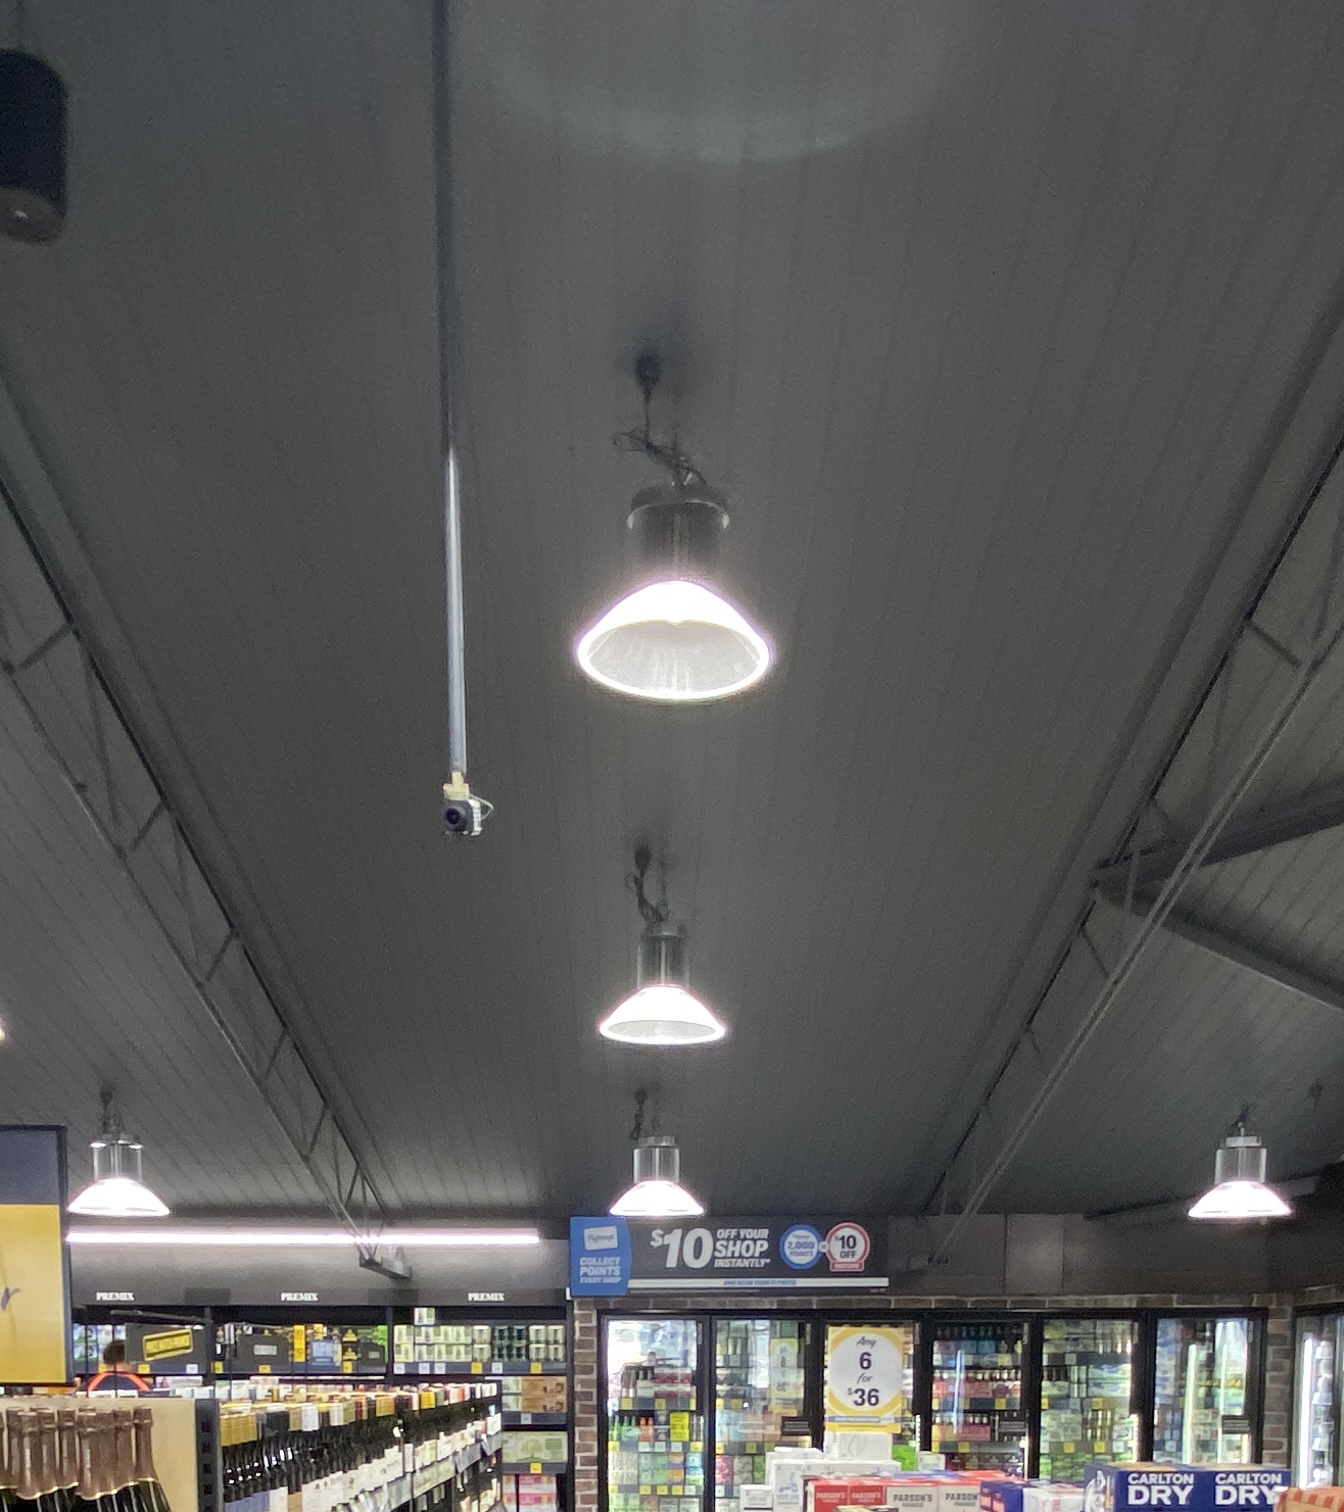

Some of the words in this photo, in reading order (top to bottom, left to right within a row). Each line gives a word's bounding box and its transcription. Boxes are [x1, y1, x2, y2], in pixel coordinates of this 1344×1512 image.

[716, 1229, 738, 1239] OFF
[739, 1228, 769, 1239] YOUR
[787, 1240, 815, 1250] 2,000
[834, 1235, 857, 1250] $10
[650, 1228, 714, 1270] $10
[714, 1240, 769, 1258] SHOP
[840, 1251, 857, 1259] OFF
[579, 1256, 621, 1266] COLLECT
[579, 1266, 621, 1276] POINTS
[96, 1292, 134, 1301] PREMIX
[281, 1292, 318, 1301] PREMIX
[468, 1292, 505, 1301] PREMIX
[856, 1336, 877, 1349] Any
[859, 1352, 872, 1370] 6
[857, 1372, 873, 1384] for
[847, 1388, 880, 1406] $36
[1127, 1473, 1194, 1484] CARLTON
[1215, 1472, 1282, 1484] CARLTON
[893, 1493, 933, 1502] PARSON'S
[1127, 1485, 1194, 1505] DRY
